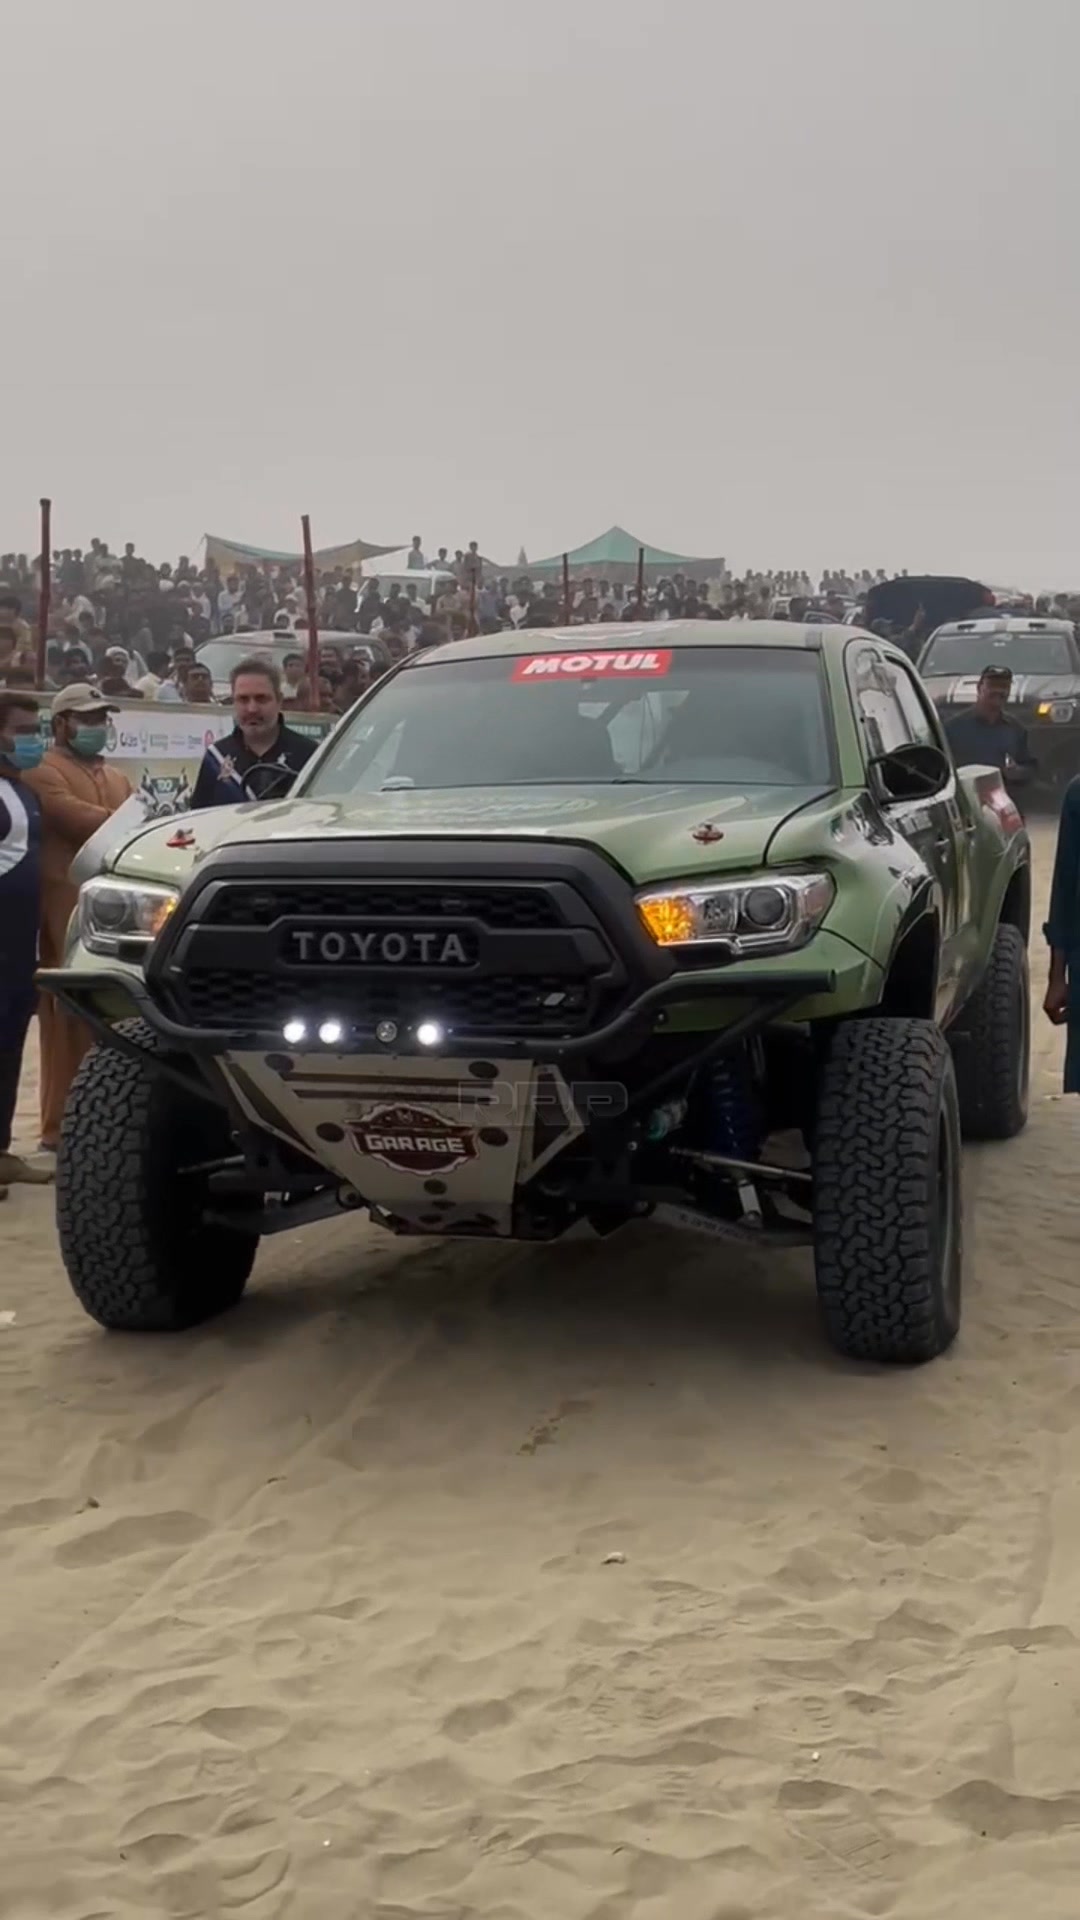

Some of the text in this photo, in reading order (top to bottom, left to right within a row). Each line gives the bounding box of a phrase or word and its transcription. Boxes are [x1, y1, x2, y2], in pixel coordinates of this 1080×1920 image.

[522, 653, 661, 675] MOTUL
[292, 931, 467, 963] TOYOTA
[364, 1134, 466, 1154] GARAGE
